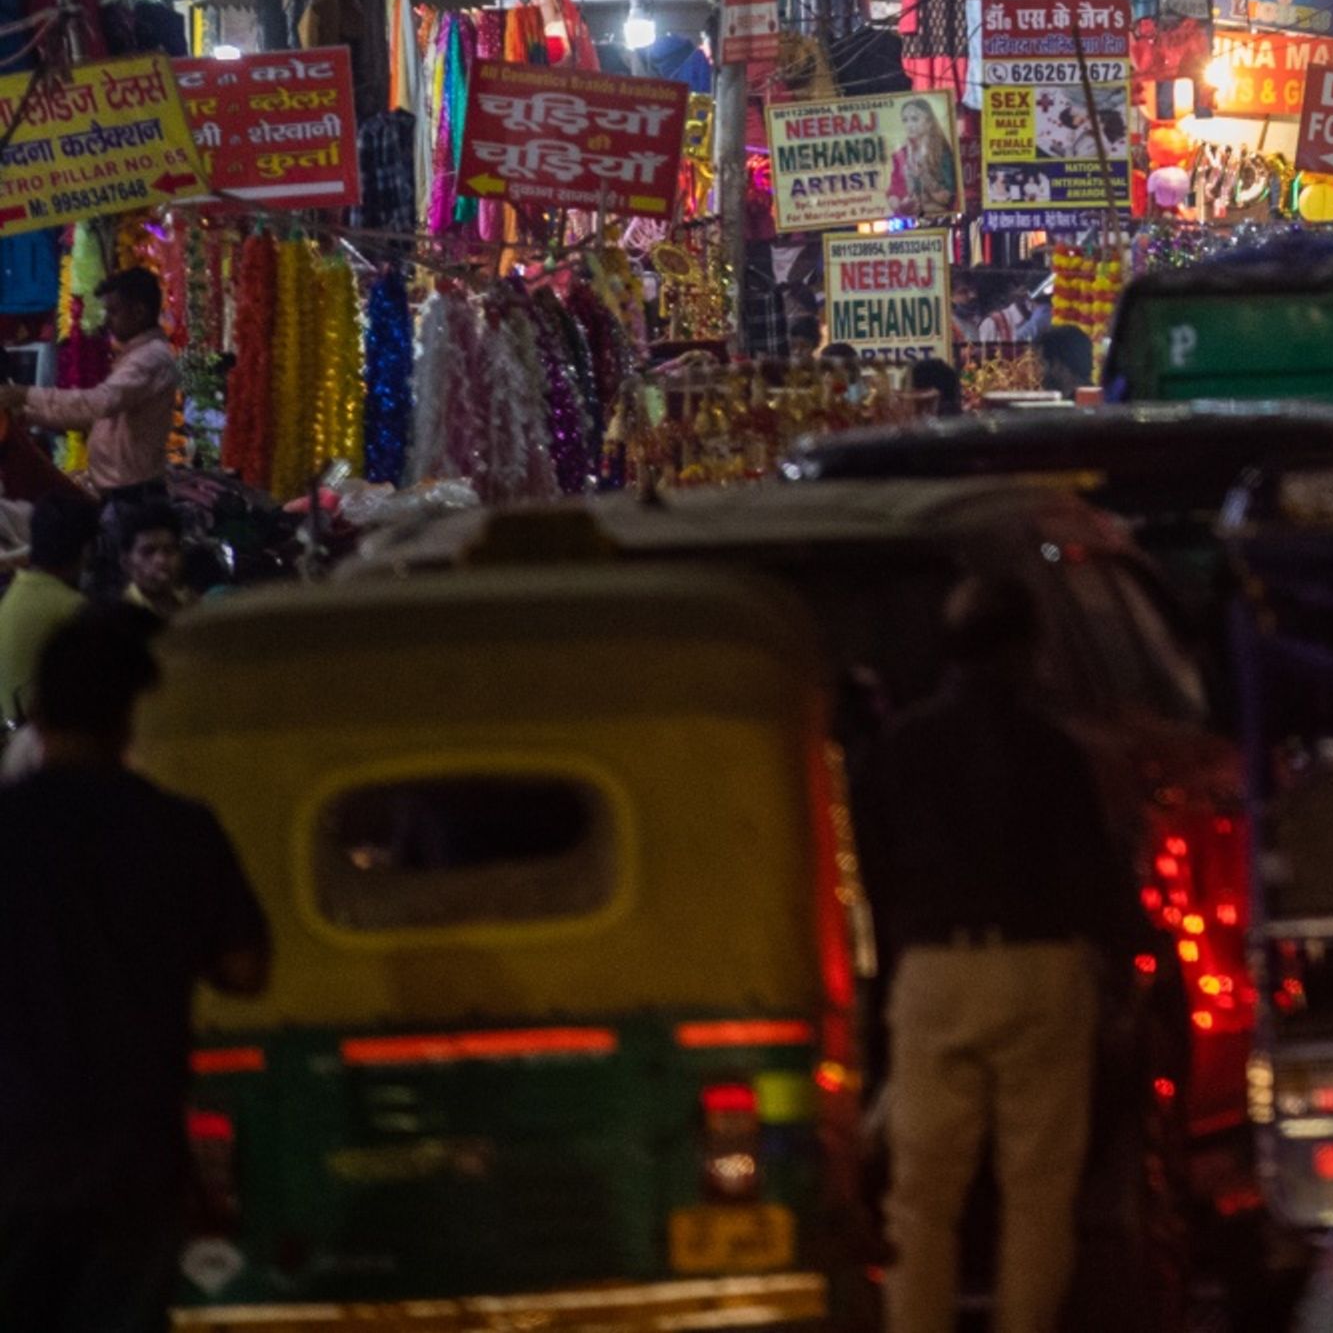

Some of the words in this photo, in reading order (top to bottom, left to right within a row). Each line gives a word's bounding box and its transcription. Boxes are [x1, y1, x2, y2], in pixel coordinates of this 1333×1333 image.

[990, 92, 1031, 108] SEX
[786, 112, 877, 140] NEERAJ
[995, 118, 1027, 129] MALE
[777, 136, 886, 172] MEHANDI
[989, 138, 1033, 148] FEMALE
[51, 164, 120, 189] PILLAR
[791, 170, 879, 197] ARTIST
[839, 257, 935, 291] NEERAJ
[833, 297, 941, 340] MEHANDI
[859, 346, 936, 366] RTIST
[1169, 323, 1199, 366] P
